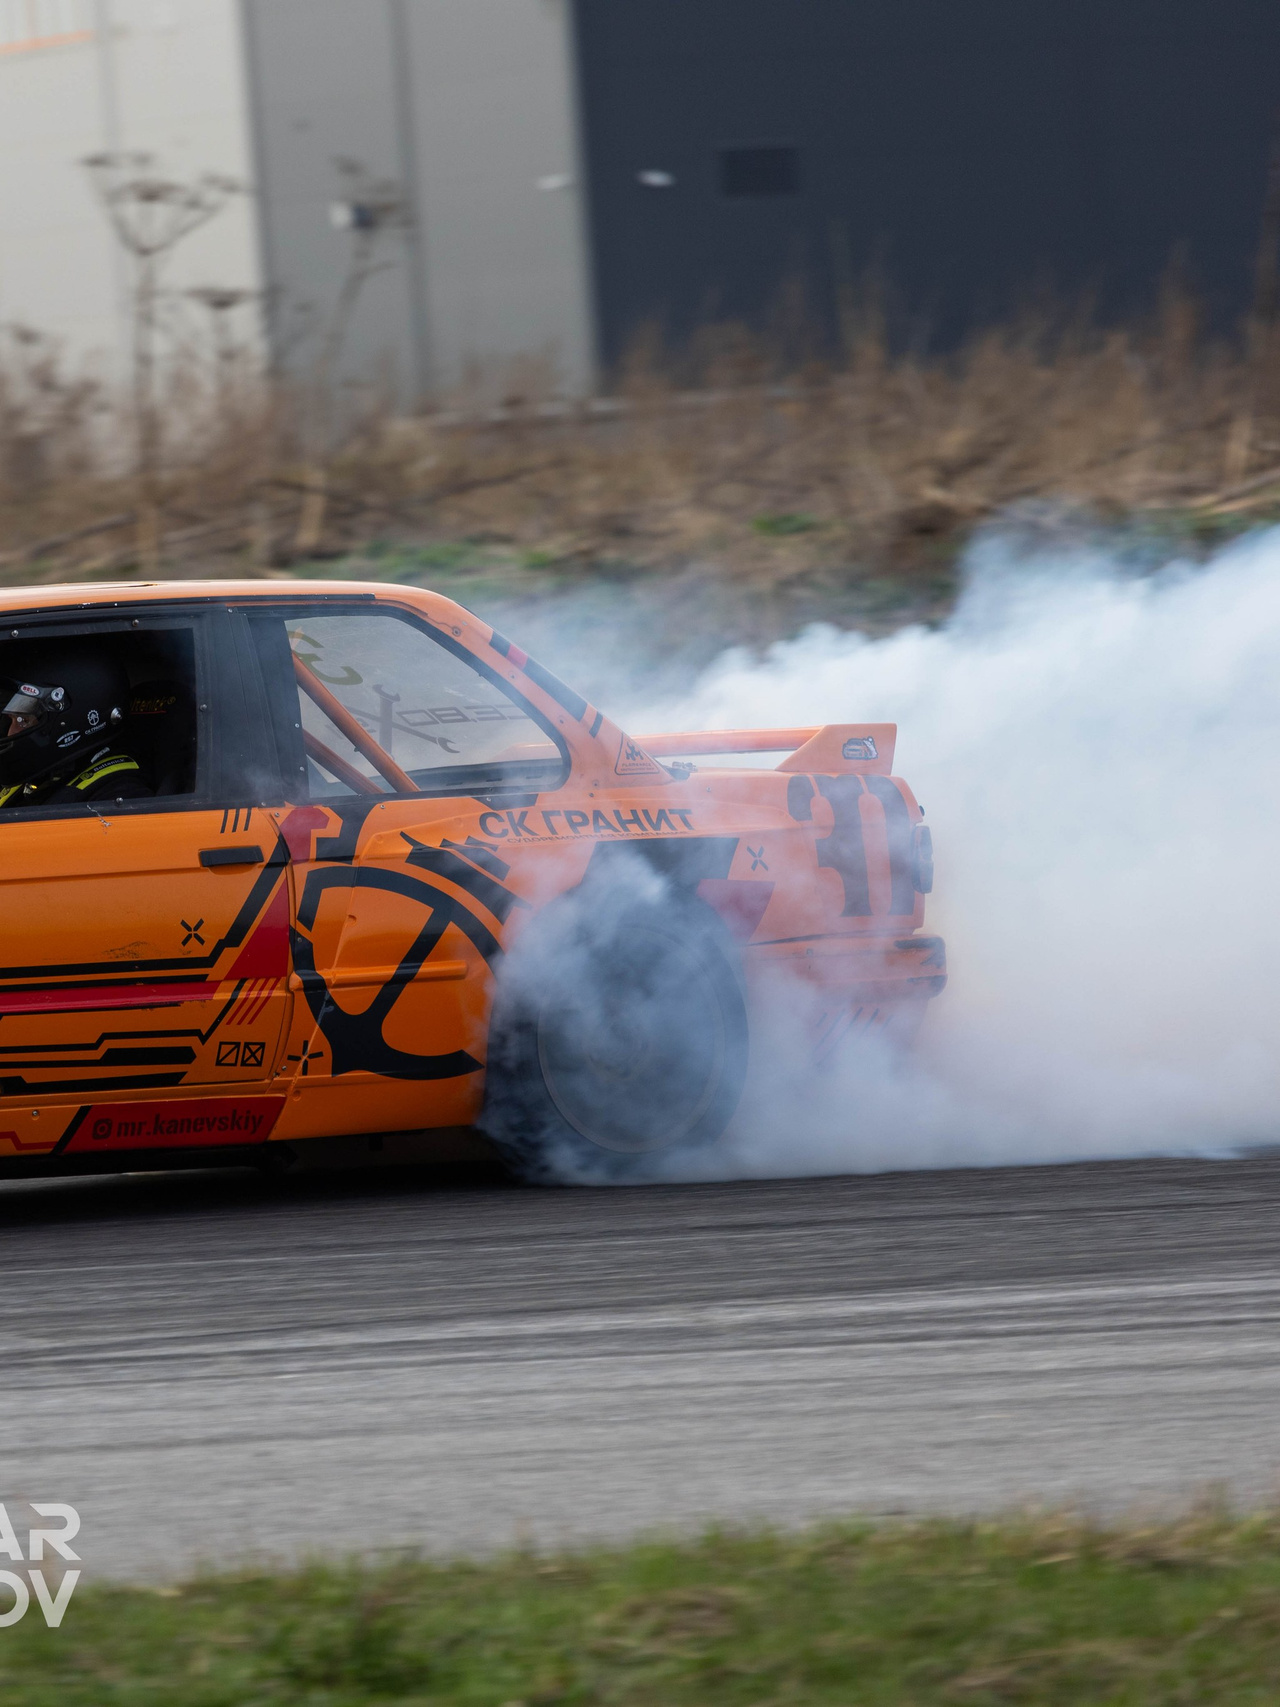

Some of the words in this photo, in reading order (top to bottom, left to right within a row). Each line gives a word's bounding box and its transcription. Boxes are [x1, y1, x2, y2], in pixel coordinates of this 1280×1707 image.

[479, 810, 539, 839] СК
[541, 809, 696, 836] ГРАНИТ
[116, 1109, 264, 1137] mr.kanevskiy
